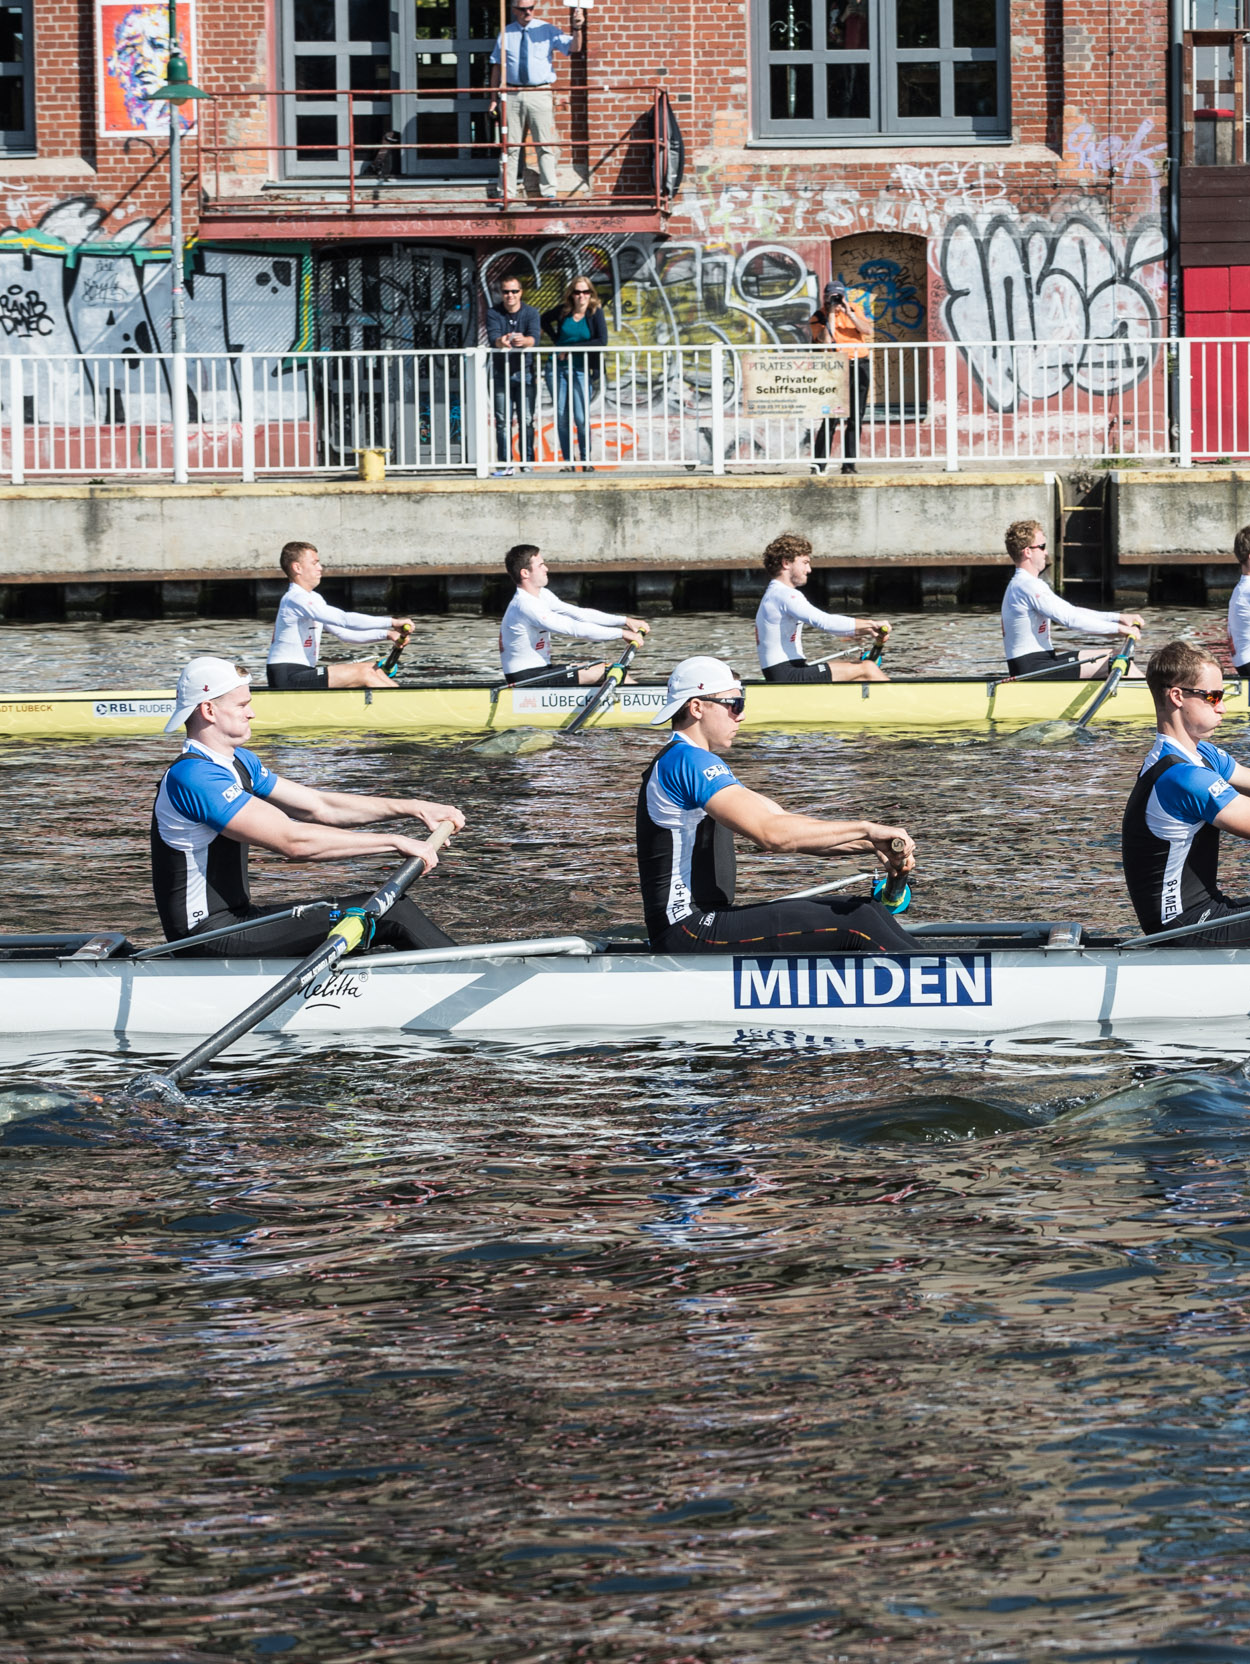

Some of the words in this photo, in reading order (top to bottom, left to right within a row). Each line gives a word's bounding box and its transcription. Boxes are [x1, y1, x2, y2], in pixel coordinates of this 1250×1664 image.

[775, 375, 818, 384] Privater
[756, 386, 837, 395] Schiffsanleger
[16, 704, 53, 713] LÜBECK
[110, 703, 136, 713] RBL
[740, 956, 986, 1006] MINDEN
